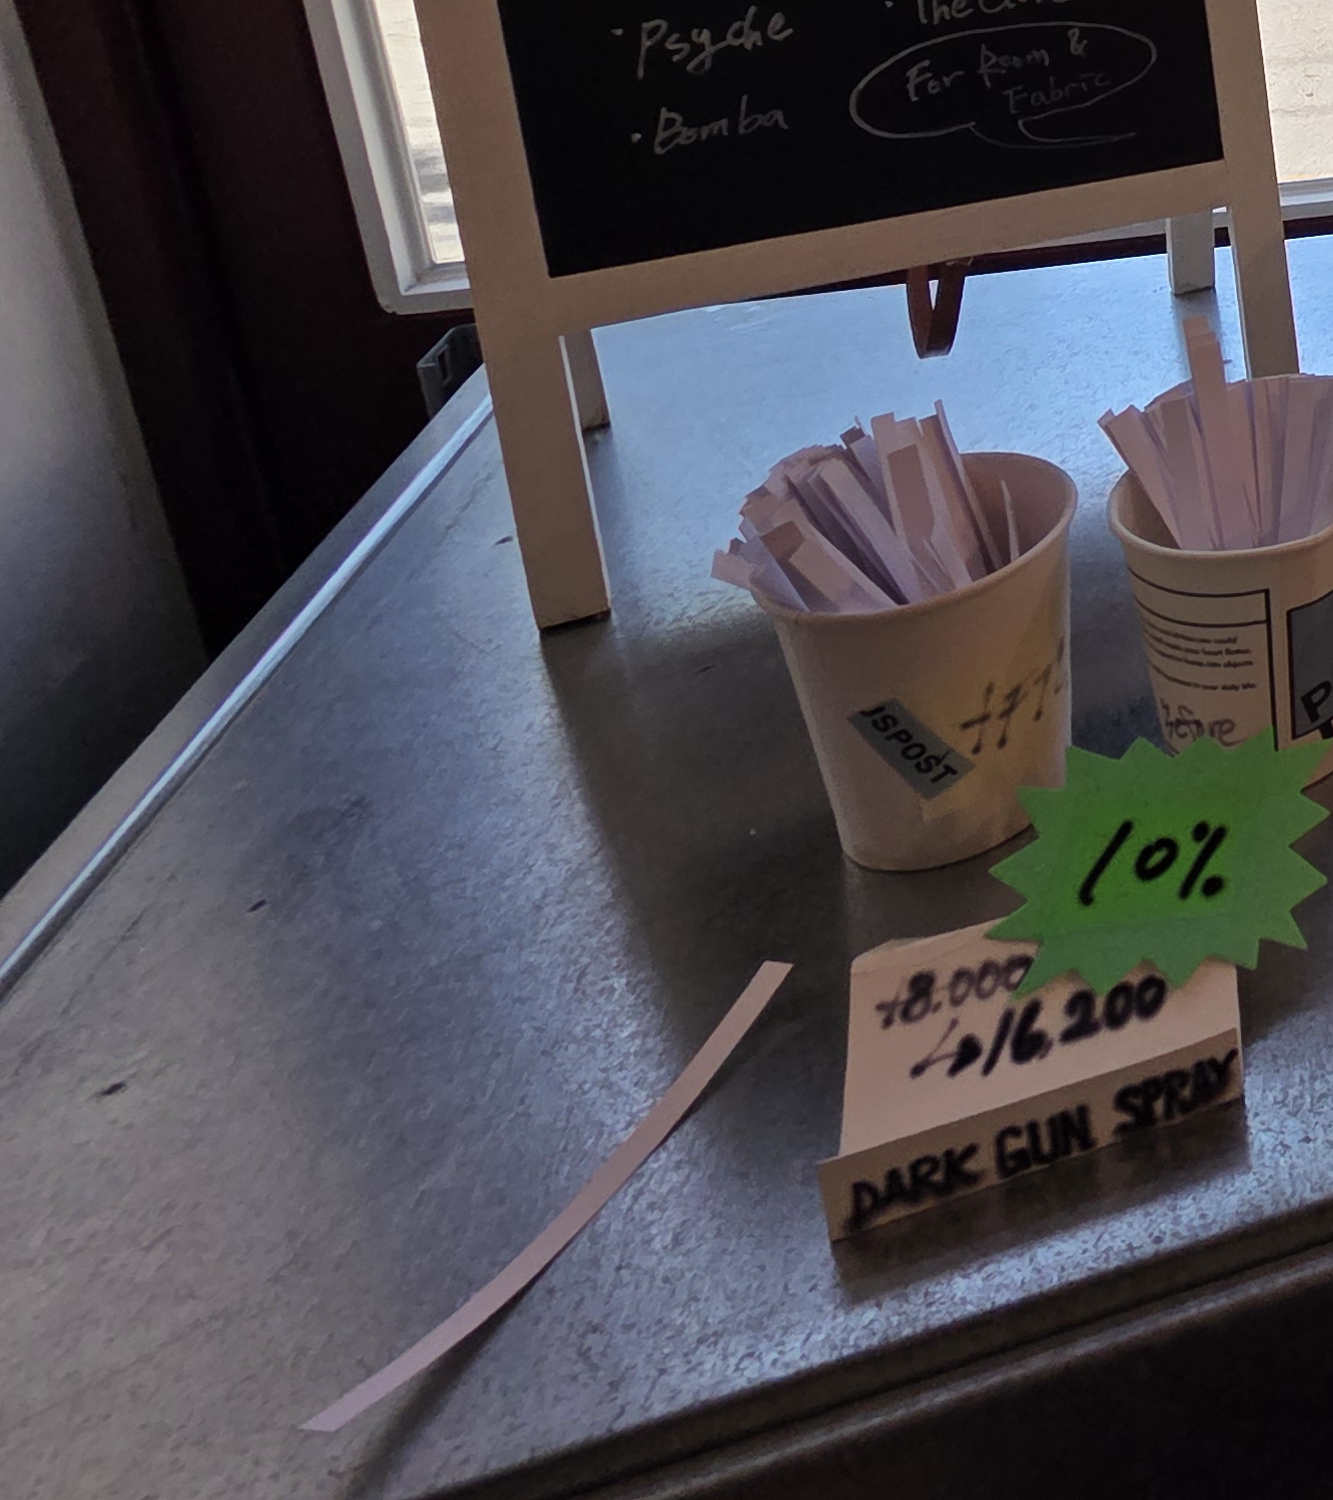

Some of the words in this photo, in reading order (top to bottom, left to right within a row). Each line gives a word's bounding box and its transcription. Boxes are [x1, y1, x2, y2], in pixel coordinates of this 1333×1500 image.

[636, 5, 795, 81] Psyche
[905, 60, 965, 102] For
[1001, 72, 1113, 114] Fabric
[653, 94, 790, 156] Bomba
[1078, 819, 1229, 906] 10%
[845, 1143, 982, 1235] DARK
[995, 1105, 1095, 1181] GUN
[1114, 1048, 1239, 1137] SPRAY
